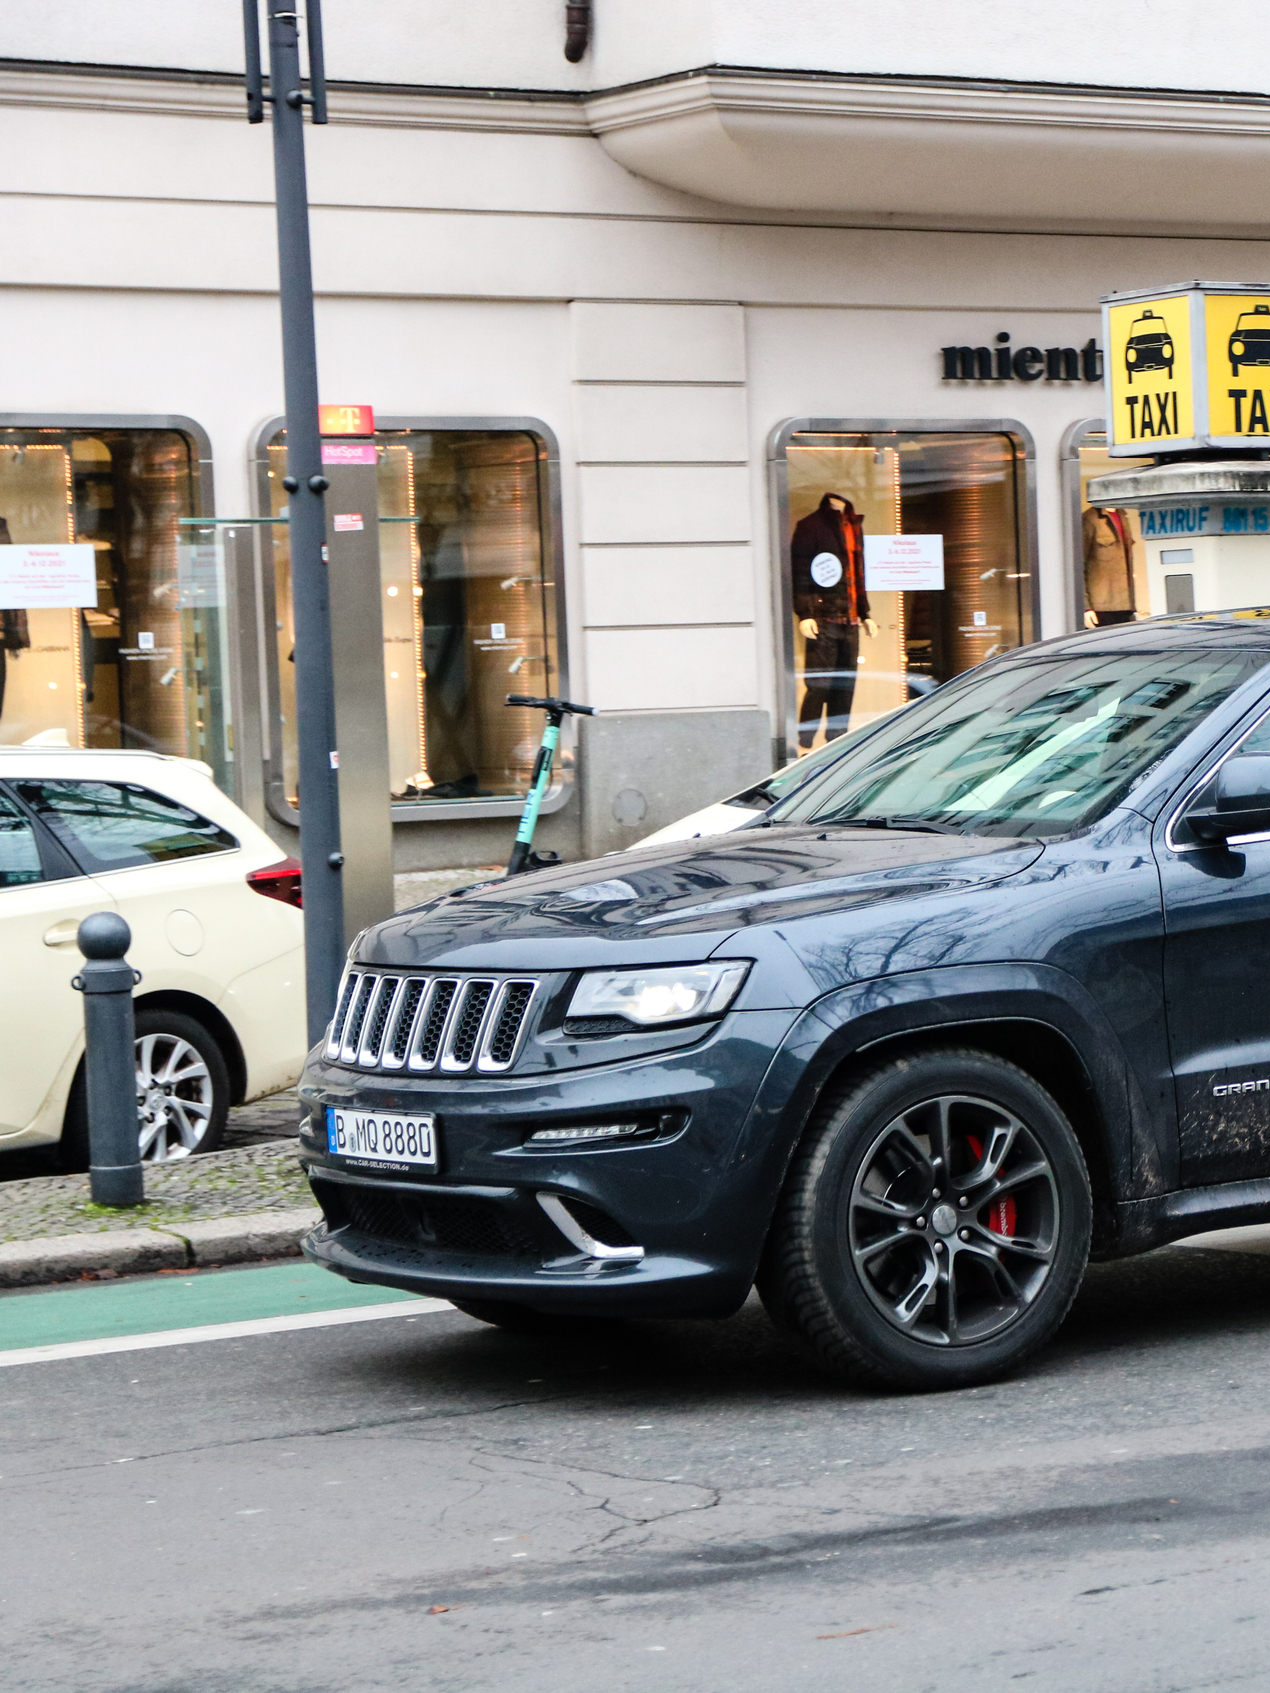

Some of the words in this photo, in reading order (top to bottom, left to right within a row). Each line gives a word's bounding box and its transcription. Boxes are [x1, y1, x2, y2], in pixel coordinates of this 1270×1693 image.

[942, 332, 1104, 382] mient
[1125, 391, 1179, 440] TAXI
[324, 446, 363, 458] HotSpot
[1139, 506, 1210, 535] TAXIRUF
[1252, 507, 1269, 532] 15
[336, 1114, 347, 1149] B
[355, 1117, 379, 1154] MQ
[382, 1120, 432, 1158] 8880
[345, 1159, 410, 1172] www.CAR-SELECTION.de
